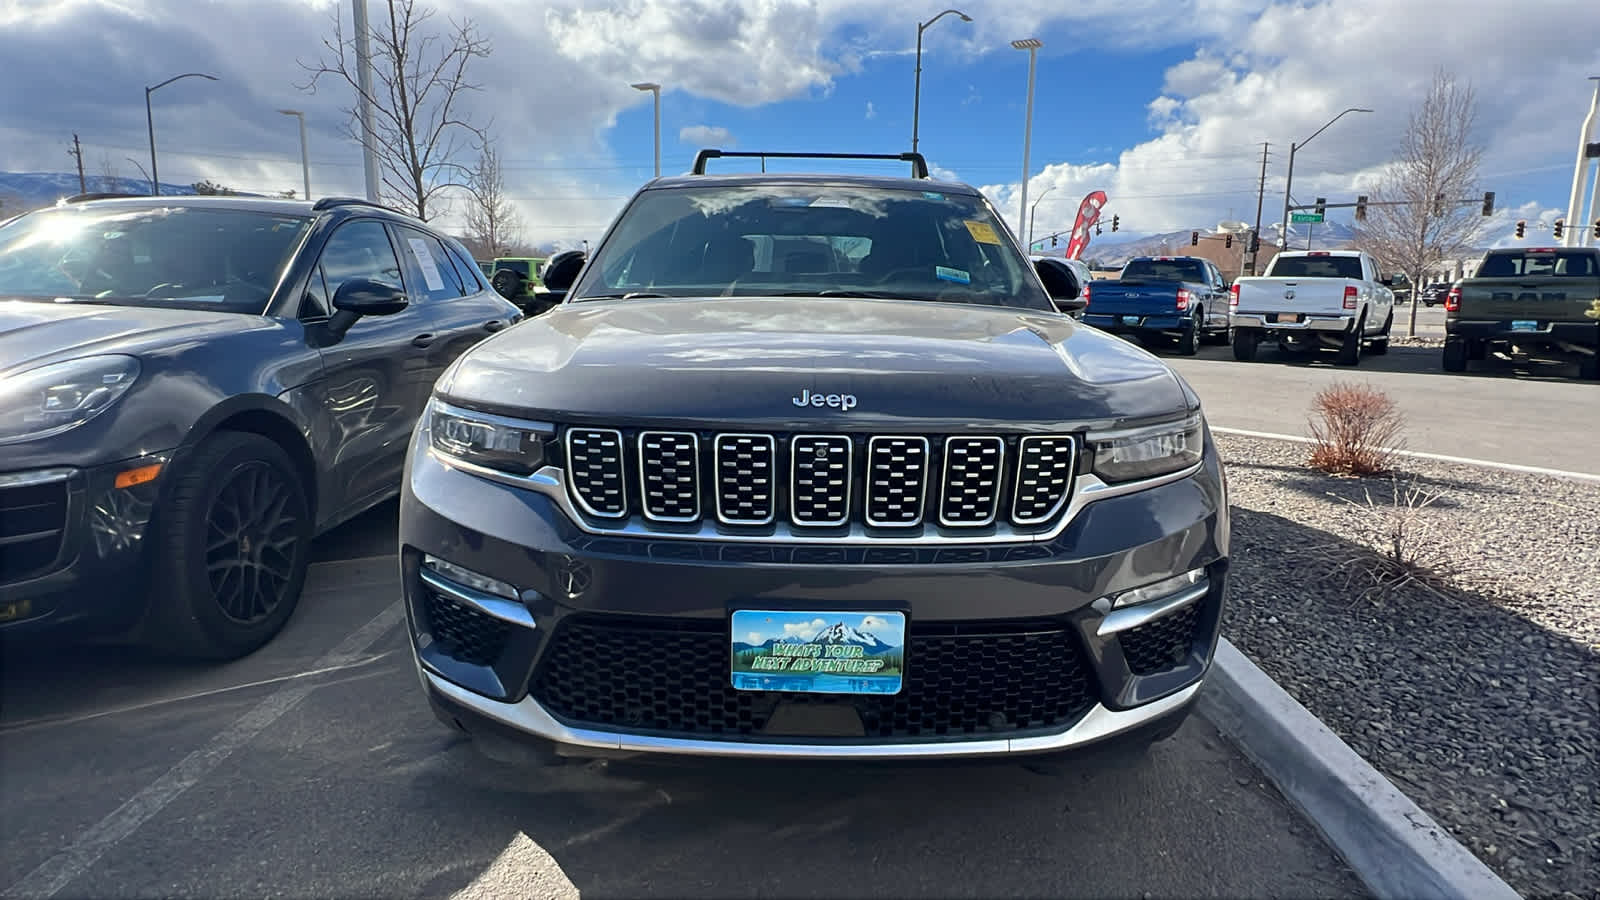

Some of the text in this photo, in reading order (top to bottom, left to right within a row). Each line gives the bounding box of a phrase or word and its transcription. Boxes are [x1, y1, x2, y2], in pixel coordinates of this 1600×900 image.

[792, 389, 857, 411] Jeep
[773, 643, 863, 658] WHAT'S YOUR
[752, 656, 884, 673] NEXT ADVENTURE?
